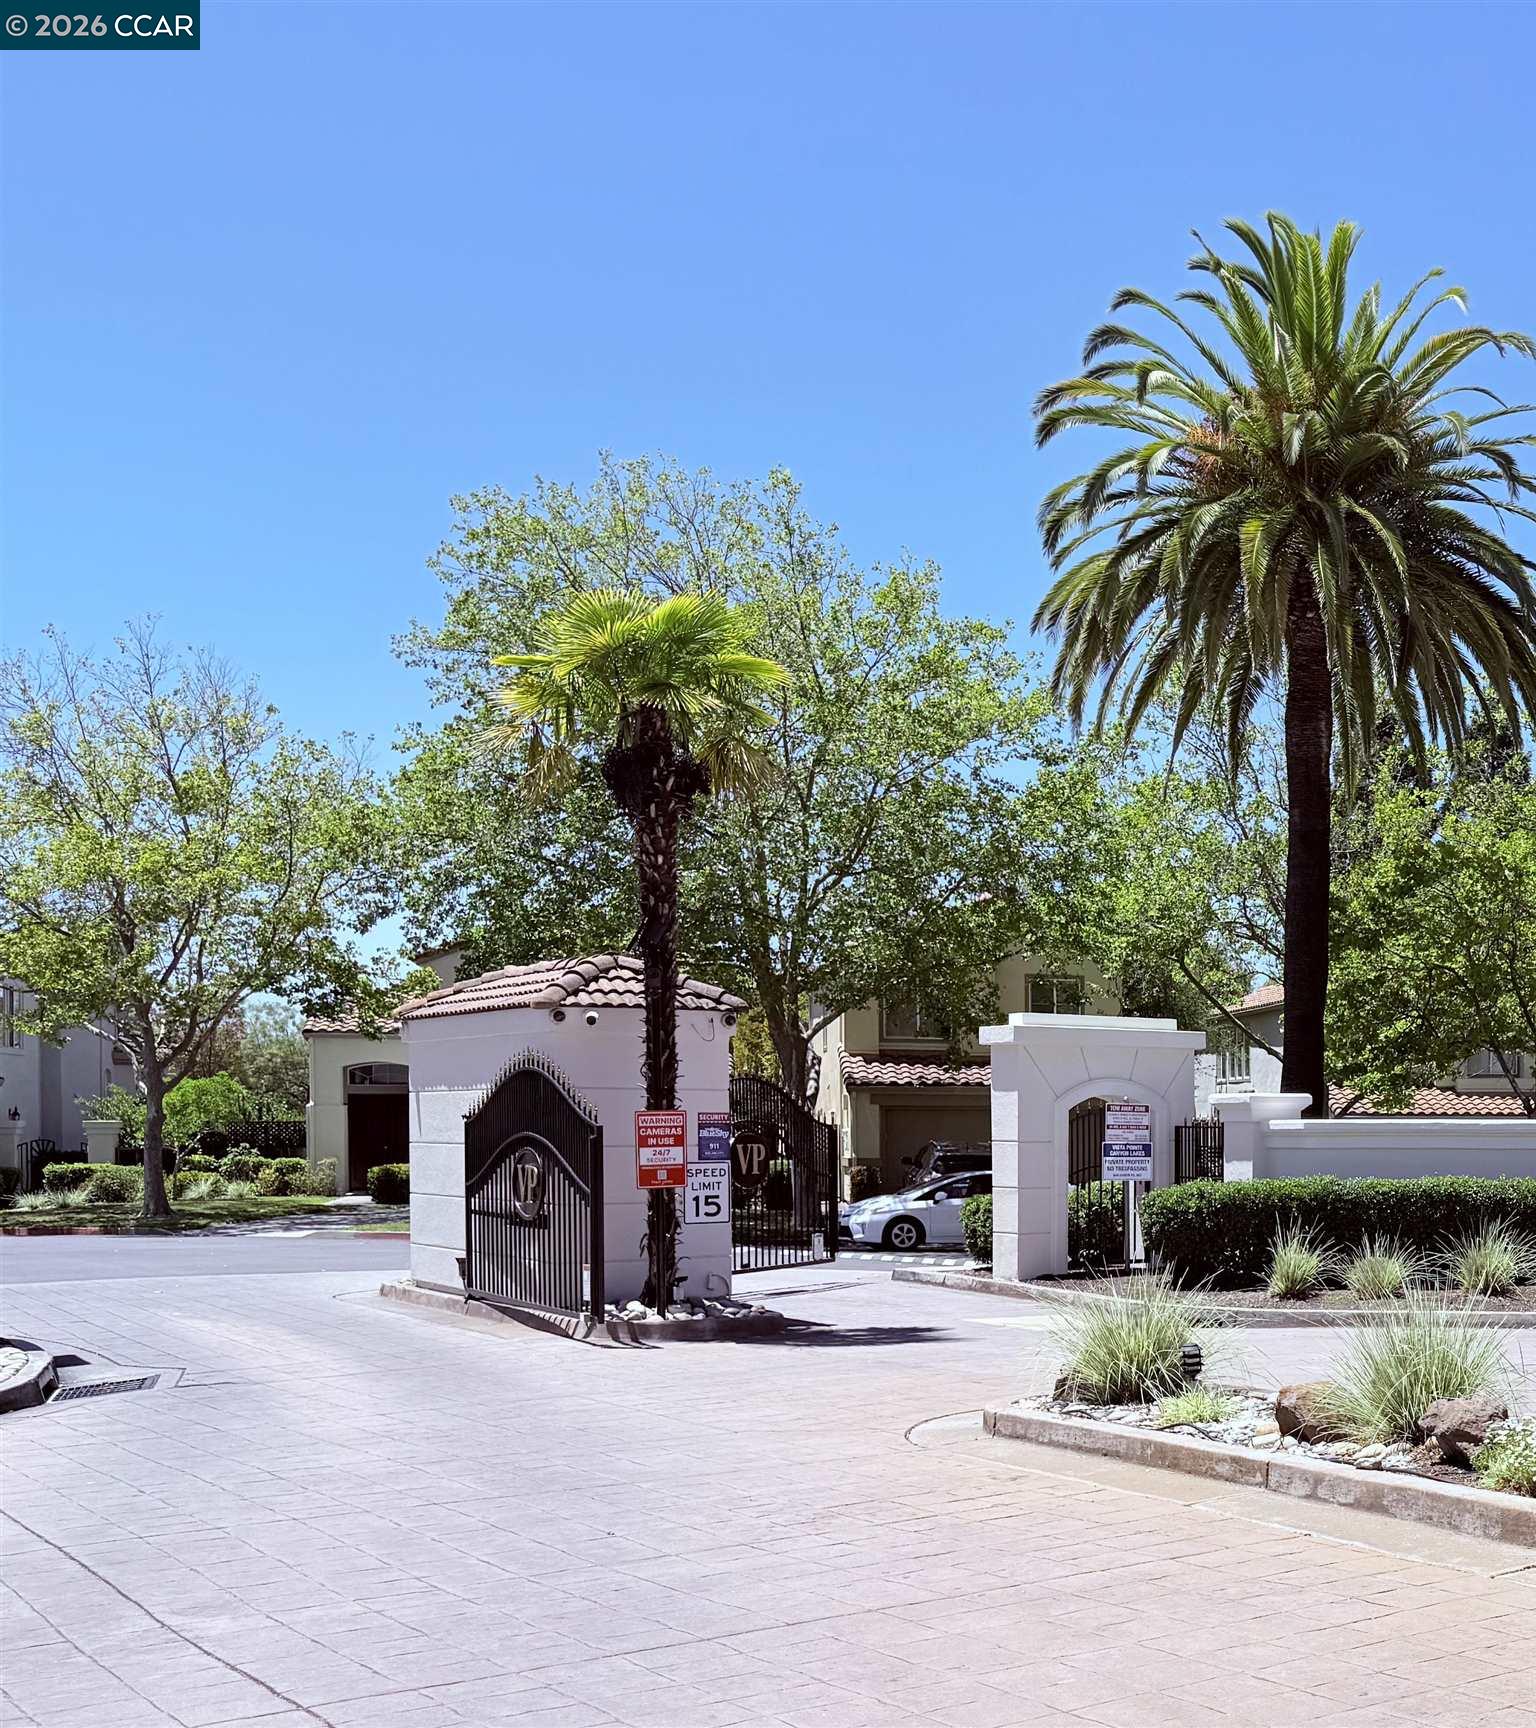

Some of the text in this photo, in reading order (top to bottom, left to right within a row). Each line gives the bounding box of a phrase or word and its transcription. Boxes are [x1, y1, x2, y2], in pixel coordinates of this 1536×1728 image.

[640, 1117, 682, 1125] WARNING
[640, 1127, 682, 1135] CAMERAS
[736, 1144, 766, 1175] VP
[687, 1168, 726, 1177] SPEED
[517, 1164, 538, 1203] VP
[691, 1182, 722, 1191] LIMIT
[692, 1195, 722, 1217] 15
